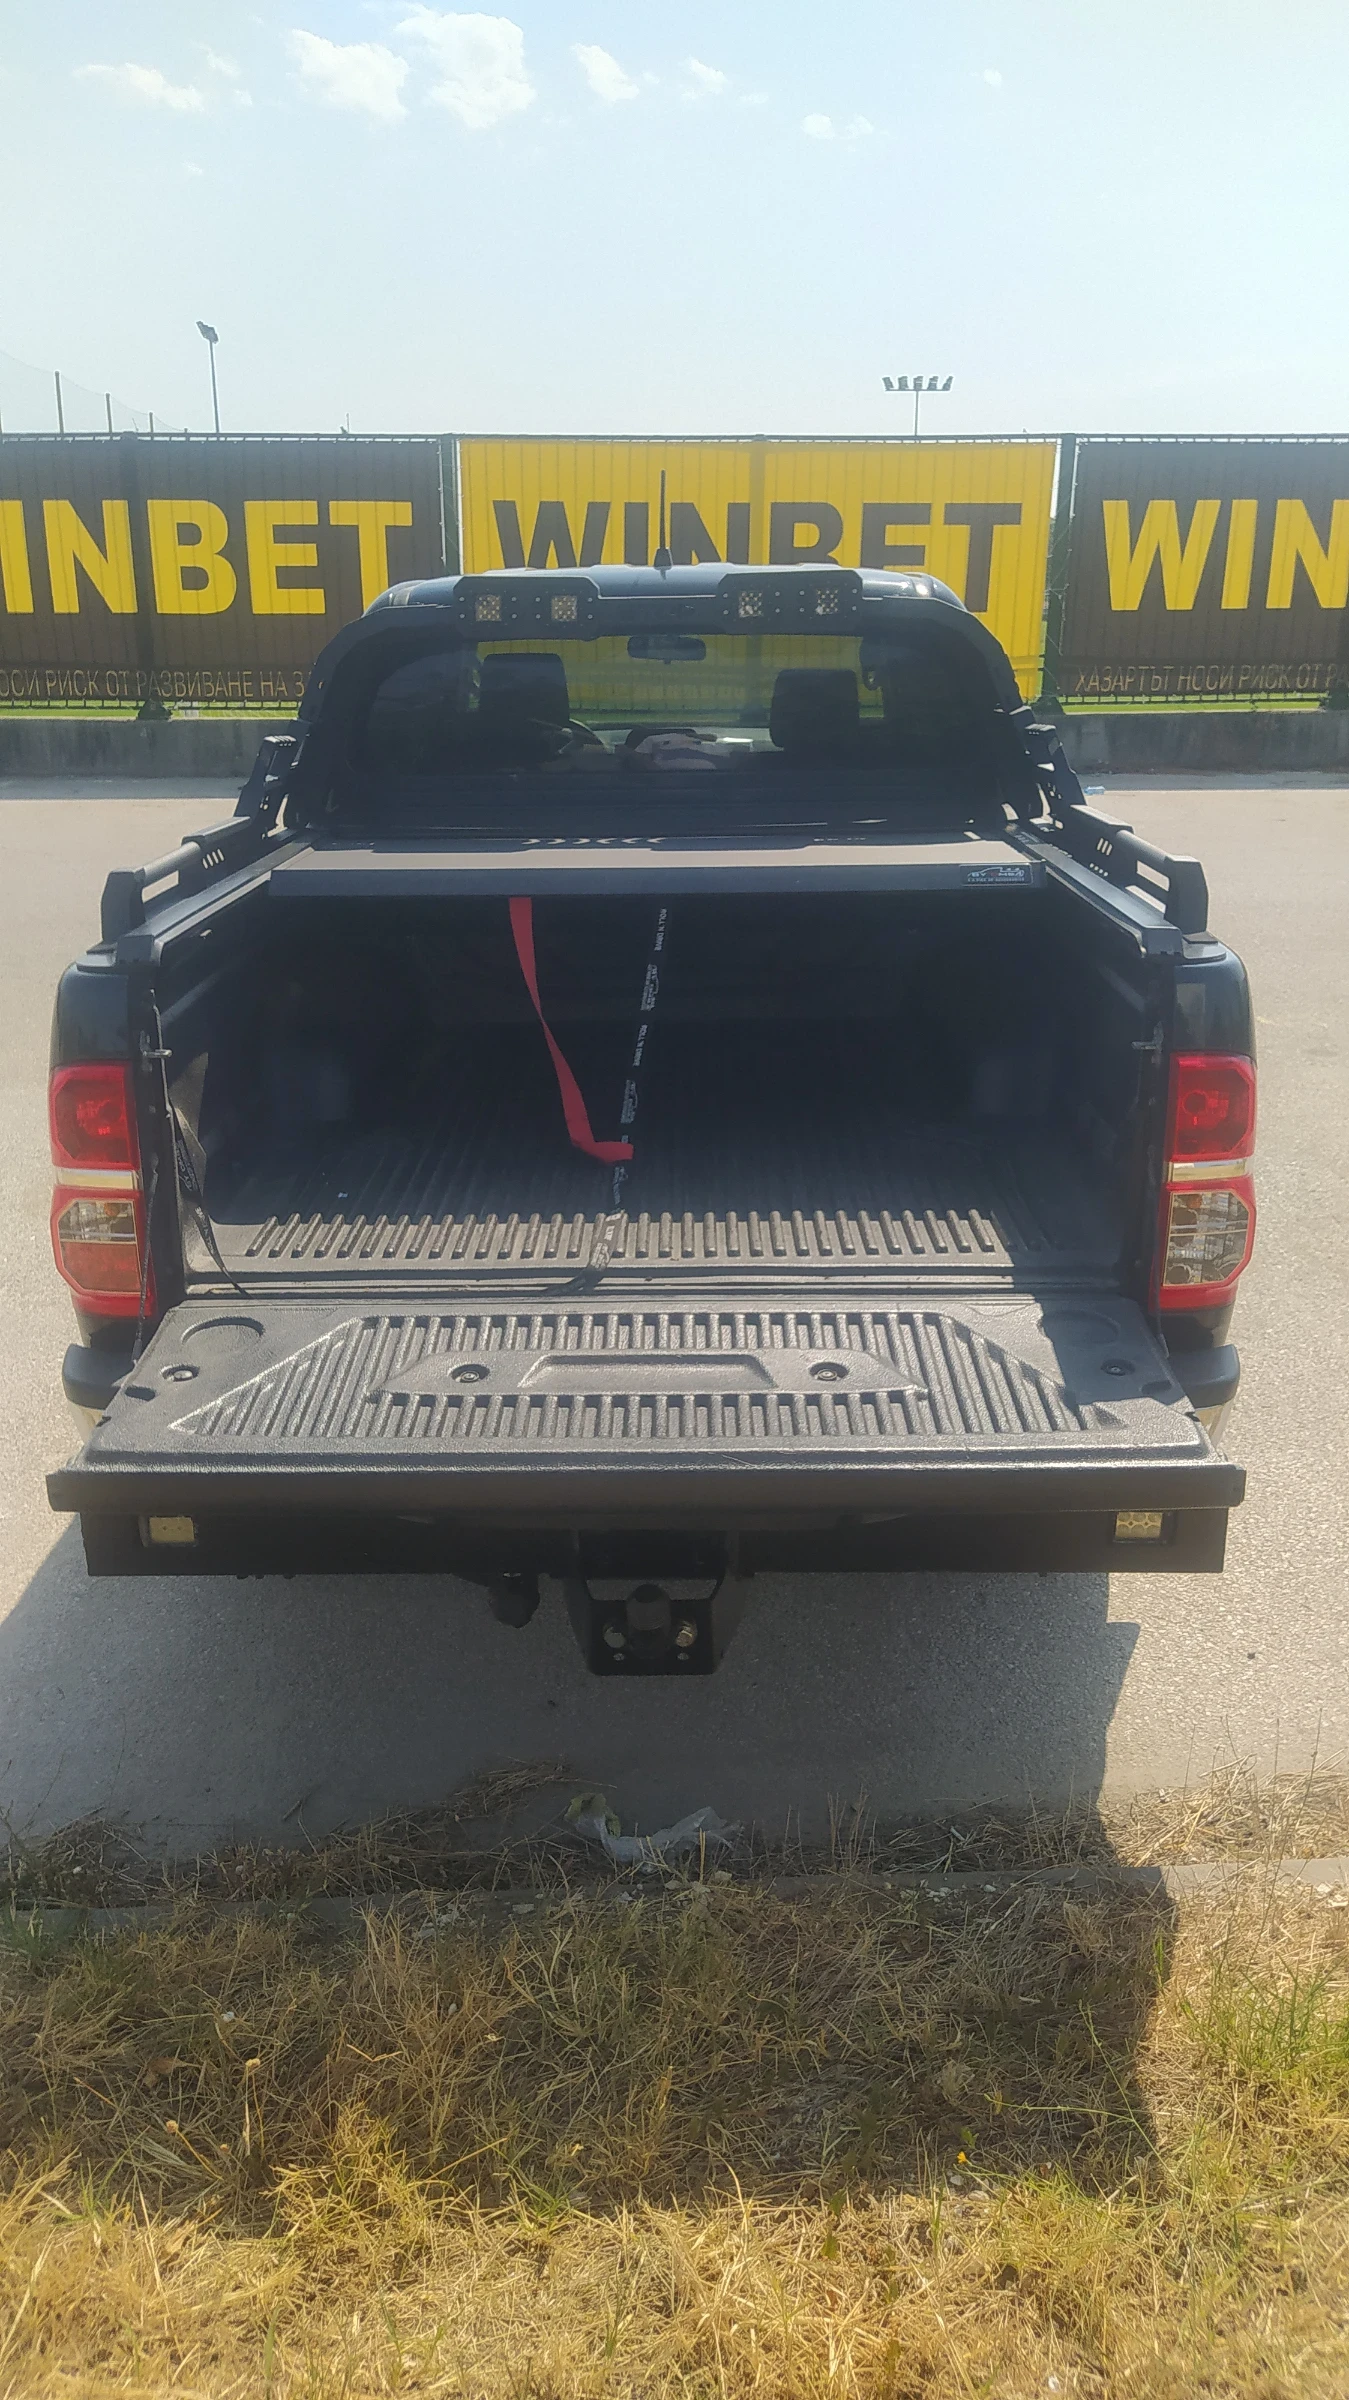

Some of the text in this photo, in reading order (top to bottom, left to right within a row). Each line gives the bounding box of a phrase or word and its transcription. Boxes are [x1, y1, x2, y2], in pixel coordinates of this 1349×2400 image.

[0, 499, 413, 615] INBET
[1103, 500, 1349, 611] WIN
[45, 669, 99, 697] РИСК
[105, 670, 129, 697] ОТ
[136, 669, 252, 698] РАЗВИВАНЕ
[259, 670, 289, 698] НА
[1297, 663, 1322, 689] ОТ
